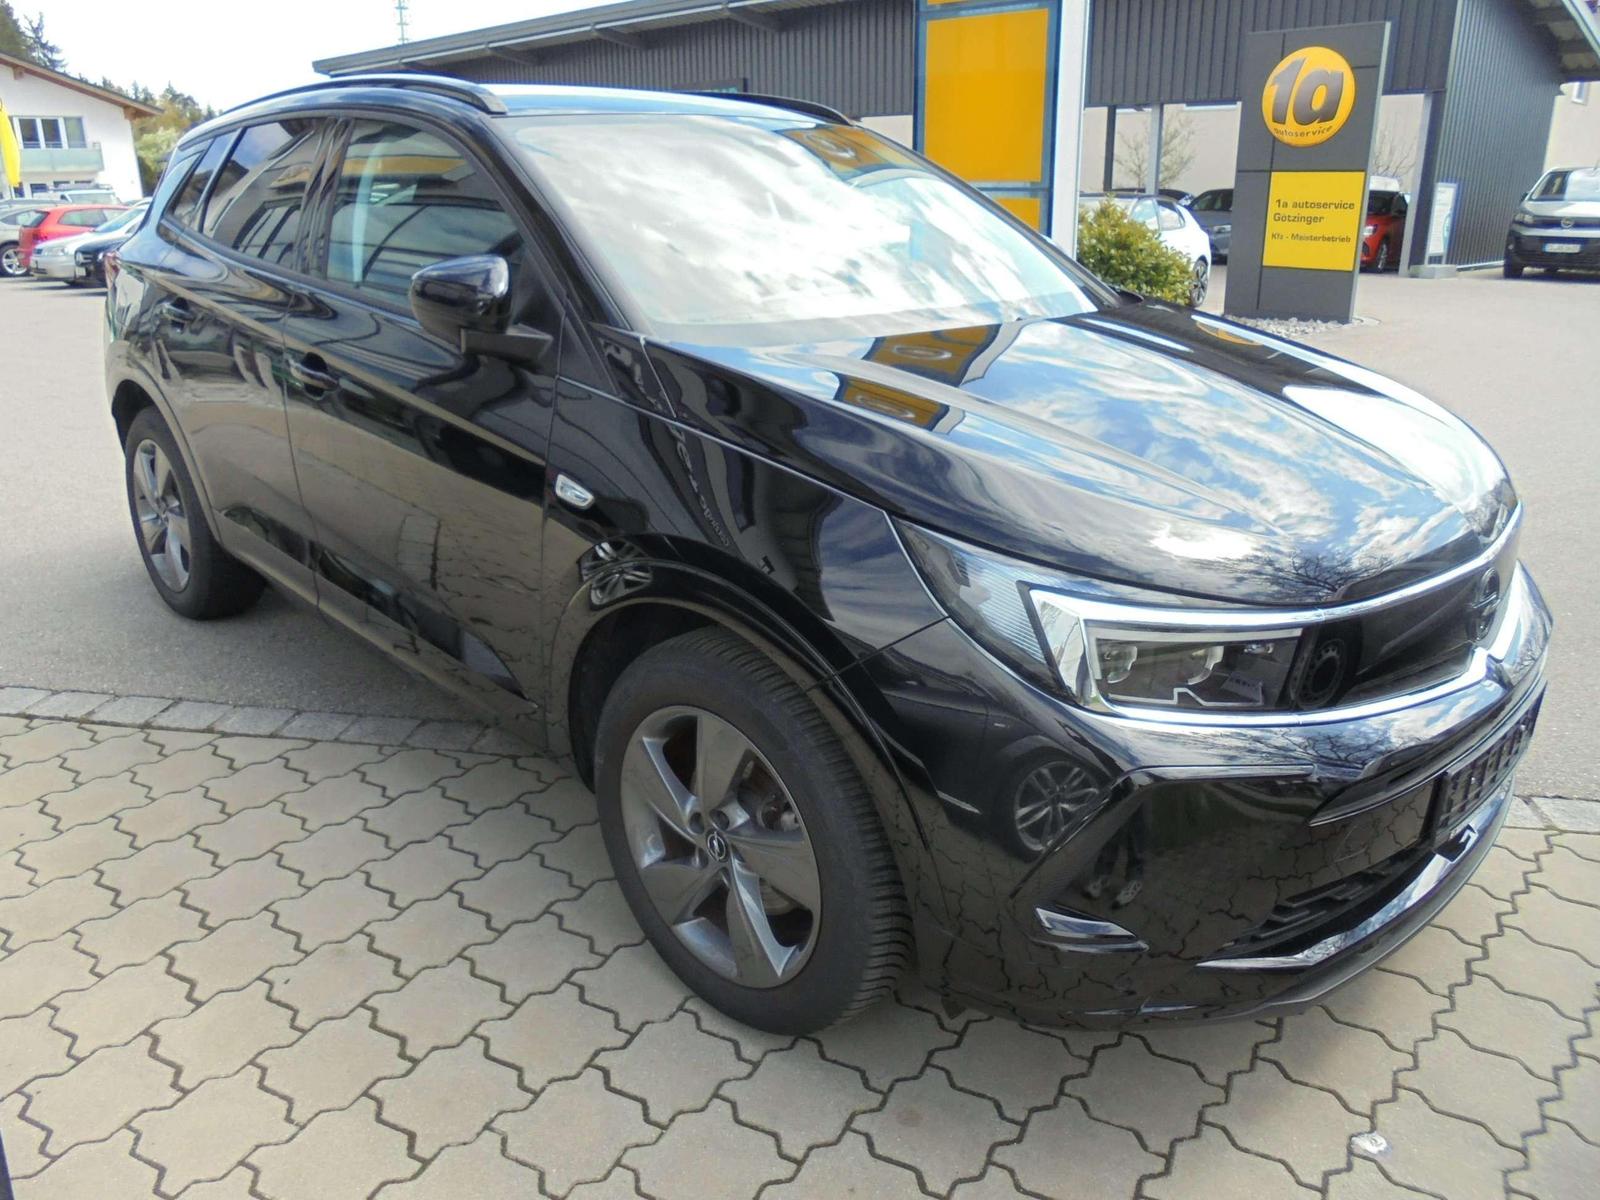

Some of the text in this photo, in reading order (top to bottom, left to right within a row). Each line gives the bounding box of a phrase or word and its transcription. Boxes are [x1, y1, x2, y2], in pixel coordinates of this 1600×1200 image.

[1271, 57, 1344, 125] 1a
[1274, 126, 1333, 137] autoservice
[1276, 199, 1355, 209] 1a autoservice
[1291, 233, 1351, 243] Meisterbetrieb
